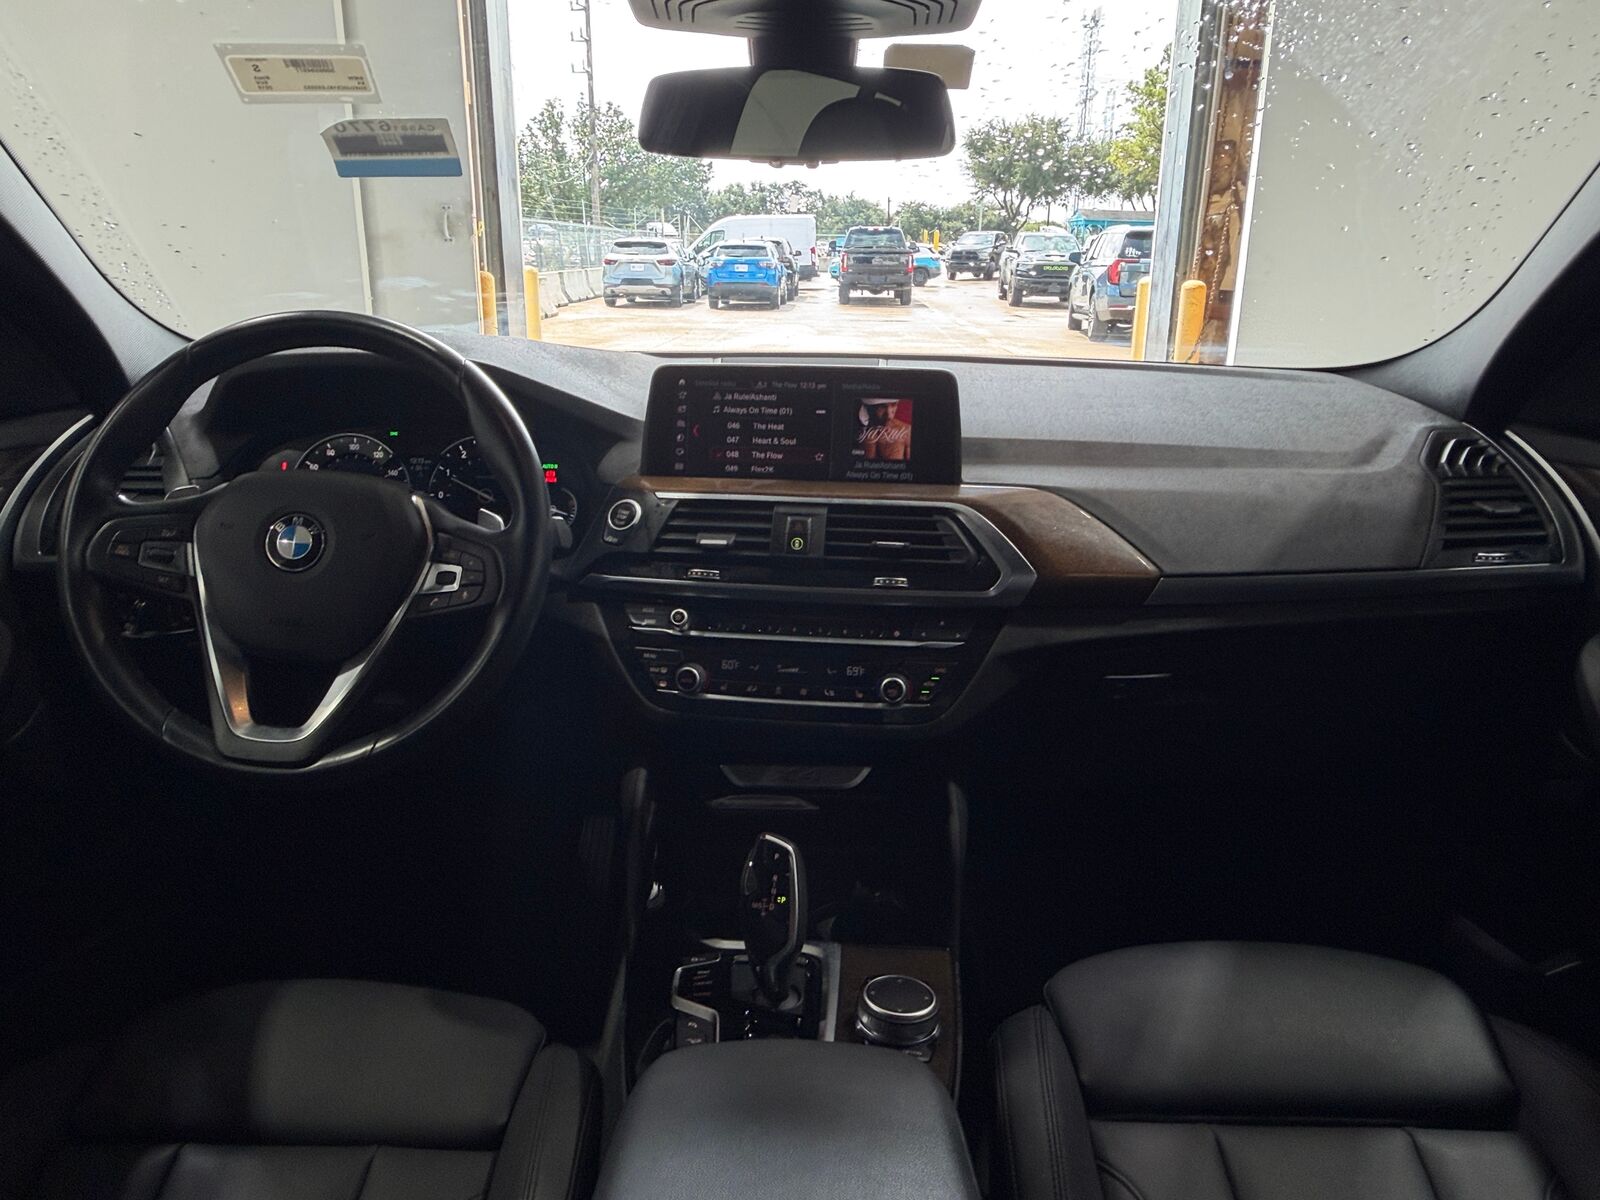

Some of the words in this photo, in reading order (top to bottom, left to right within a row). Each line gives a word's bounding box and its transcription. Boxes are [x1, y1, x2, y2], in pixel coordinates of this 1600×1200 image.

[723, 405, 748, 416] Always
[749, 406, 760, 414] On
[761, 406, 778, 415] Time
[779, 406, 793, 416] (01)
[727, 421, 740, 430] 046
[753, 422, 767, 430] The
[768, 422, 785, 431] Heat
[726, 436, 740, 444] 047
[752, 436, 772, 445] Heart
[773, 437, 780, 445] &
[781, 437, 797, 446] Soul
[373, 450, 385, 458] 120
[460, 450, 468, 459] 2
[726, 450, 740, 458] 048
[752, 451, 765, 459] The
[766, 452, 784, 460] Flow
[870, 471, 881, 480] On
[882, 471, 899, 480] Time
[438, 491, 445, 499] 0
[273, 516, 321, 534] BMW
